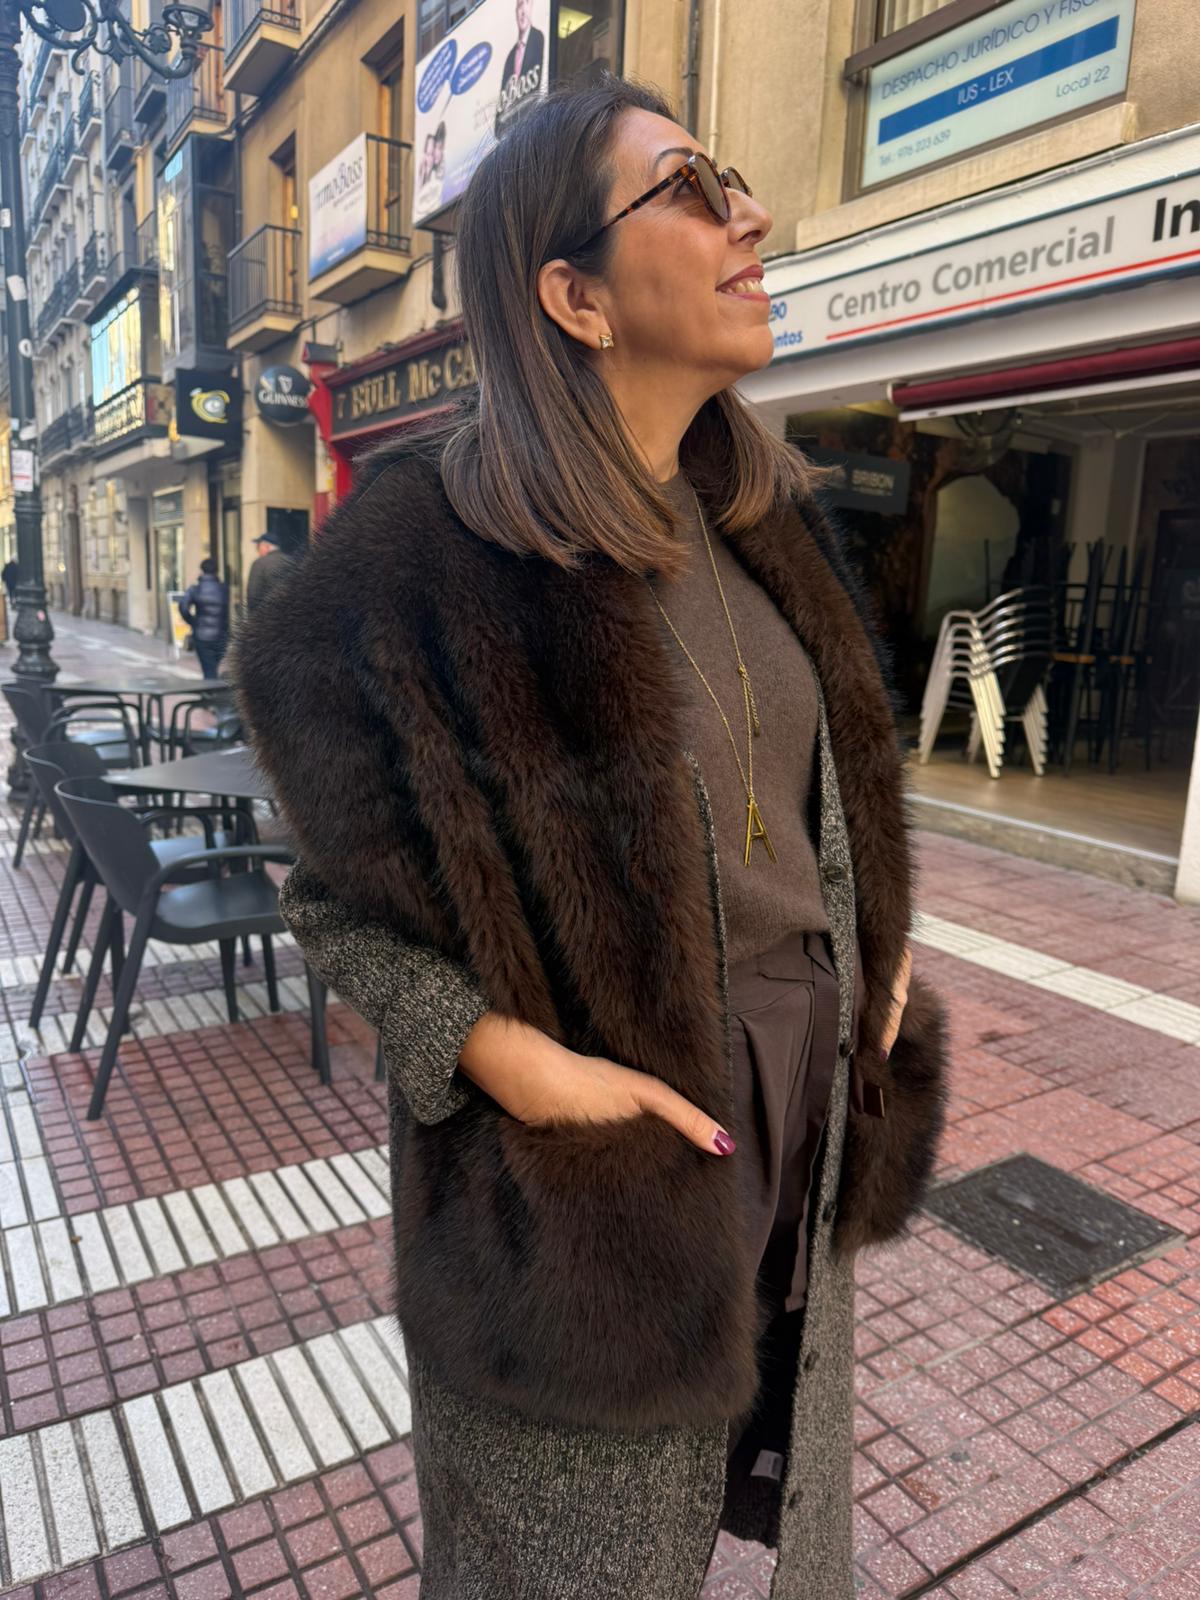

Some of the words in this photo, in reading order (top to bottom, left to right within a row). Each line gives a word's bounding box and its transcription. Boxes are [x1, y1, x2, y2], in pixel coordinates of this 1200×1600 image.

[881, 51, 960, 100] DESPACHO
[962, 12, 1040, 64] JURÍDICO
[1042, 3, 1054, 25] Y
[957, 83, 978, 105] IUS
[989, 67, 1015, 92] LEX
[1056, 72, 1092, 98] Local
[1094, 65, 1111, 84] 22
[827, 276, 921, 322] Centro
[932, 216, 1116, 296] Comercial
[1152, 196, 1200, 242] In
[351, 371, 402, 420] BULL
